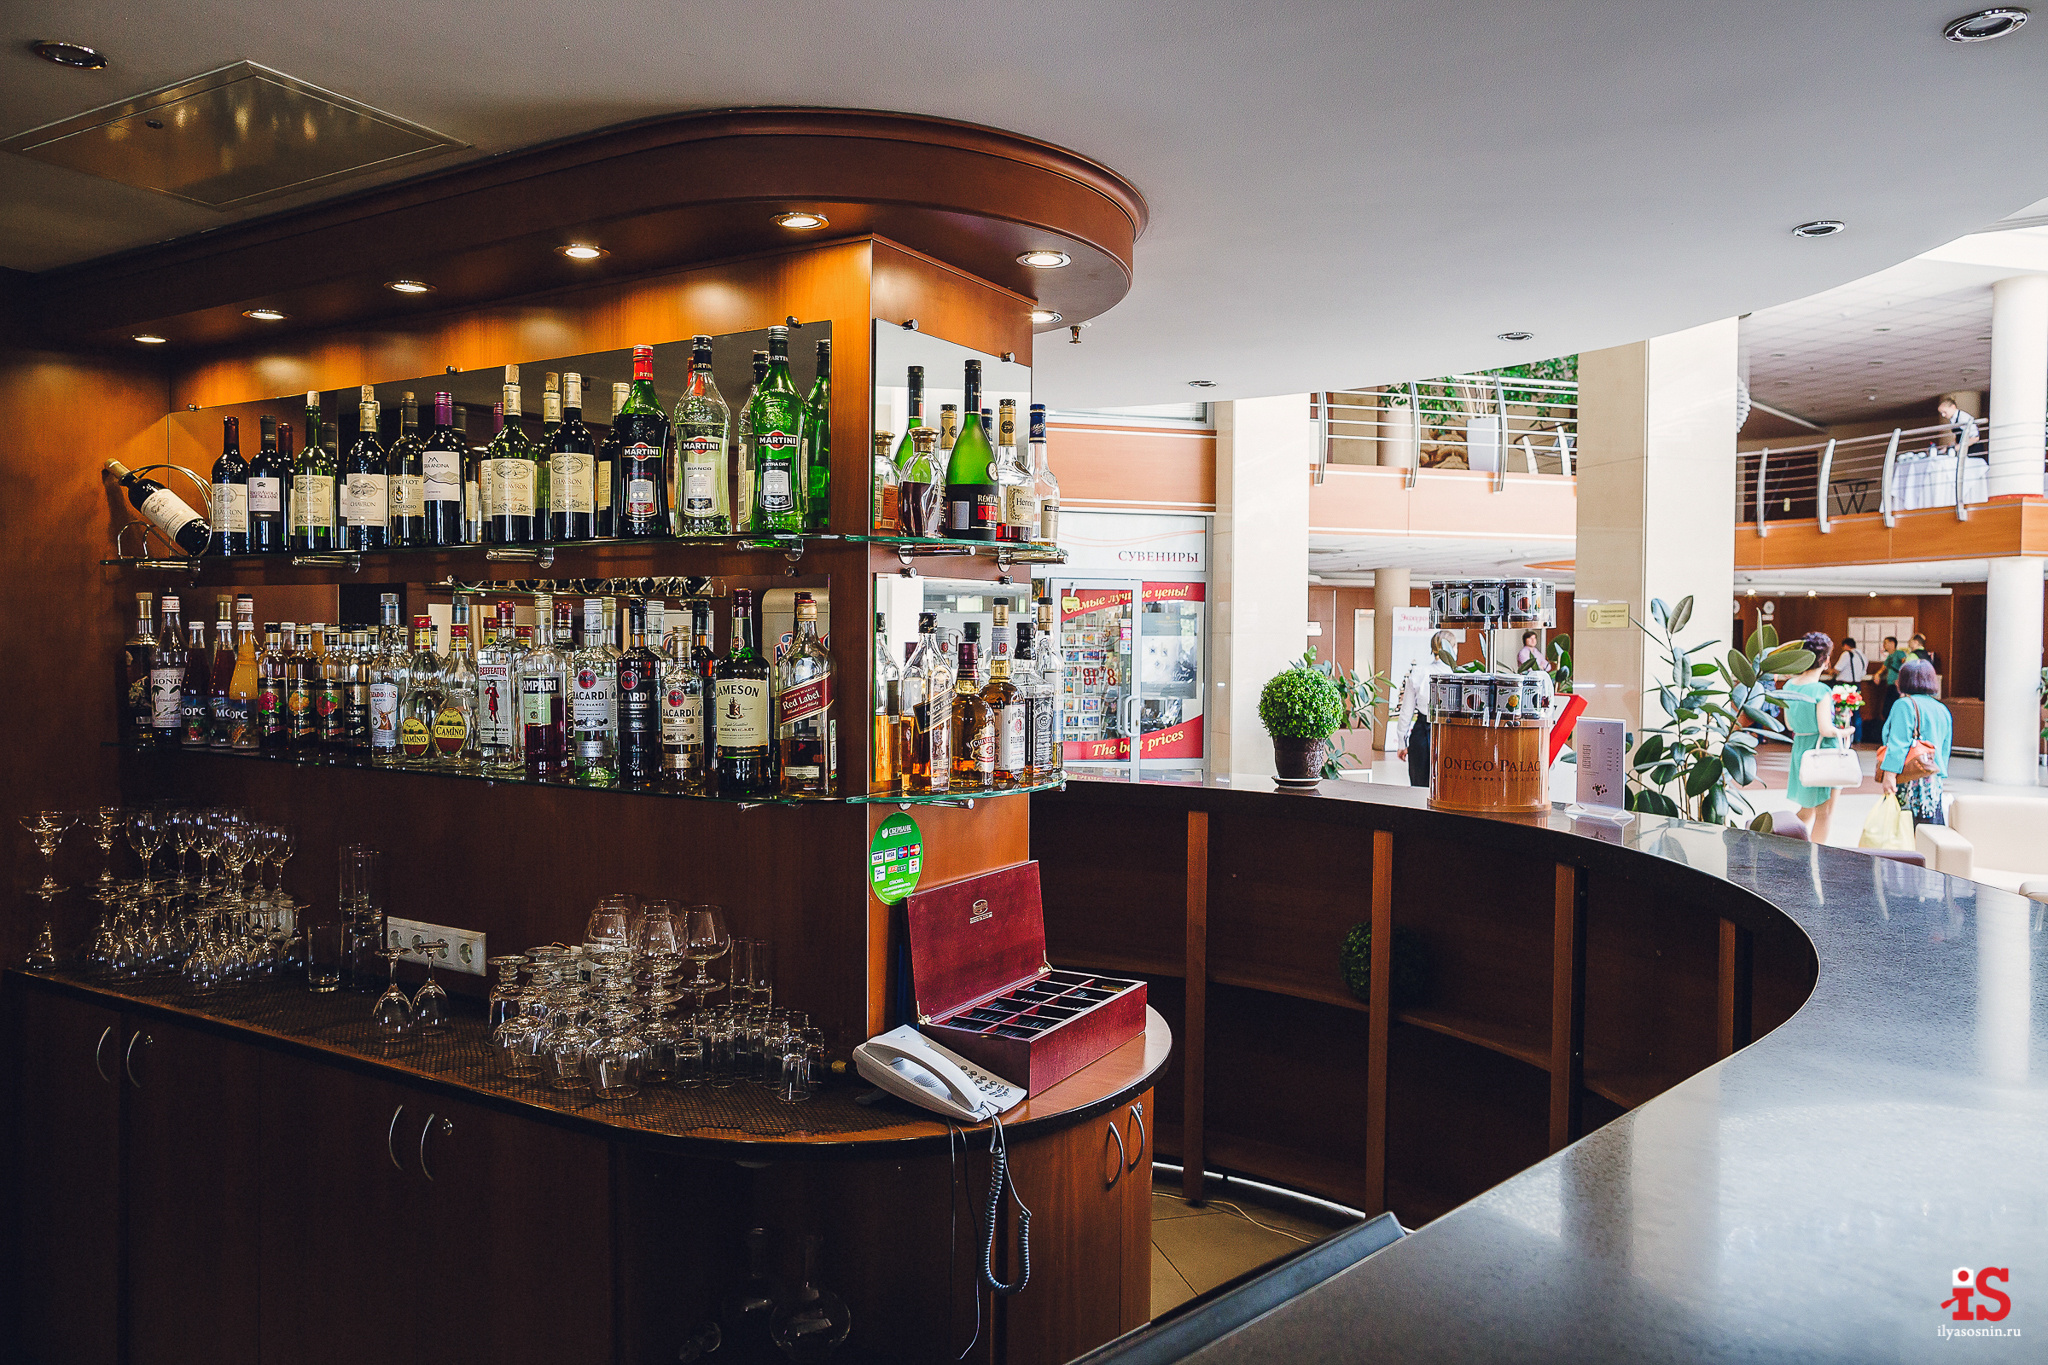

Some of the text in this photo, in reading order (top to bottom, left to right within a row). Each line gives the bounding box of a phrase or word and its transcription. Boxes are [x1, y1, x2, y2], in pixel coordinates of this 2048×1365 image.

[683, 442, 719, 450] MARTINI
[759, 436, 797, 445] MARTINI
[1117, 550, 1199, 563] СУВЕНИРЫ
[1154, 584, 1190, 600] цены!
[479, 667, 507, 677] BEEFEATER
[716, 684, 760, 698] JAMESON
[782, 689, 820, 710] Red Label
[181, 707, 206, 716] ОРС
[663, 705, 695, 717] BACARDÍ
[1092, 743, 1117, 757] The
[1147, 729, 1185, 752] prices
[1443, 756, 1541, 773] ONEGO PALAC
[888, 824, 912, 835] СБЕРБАНК
